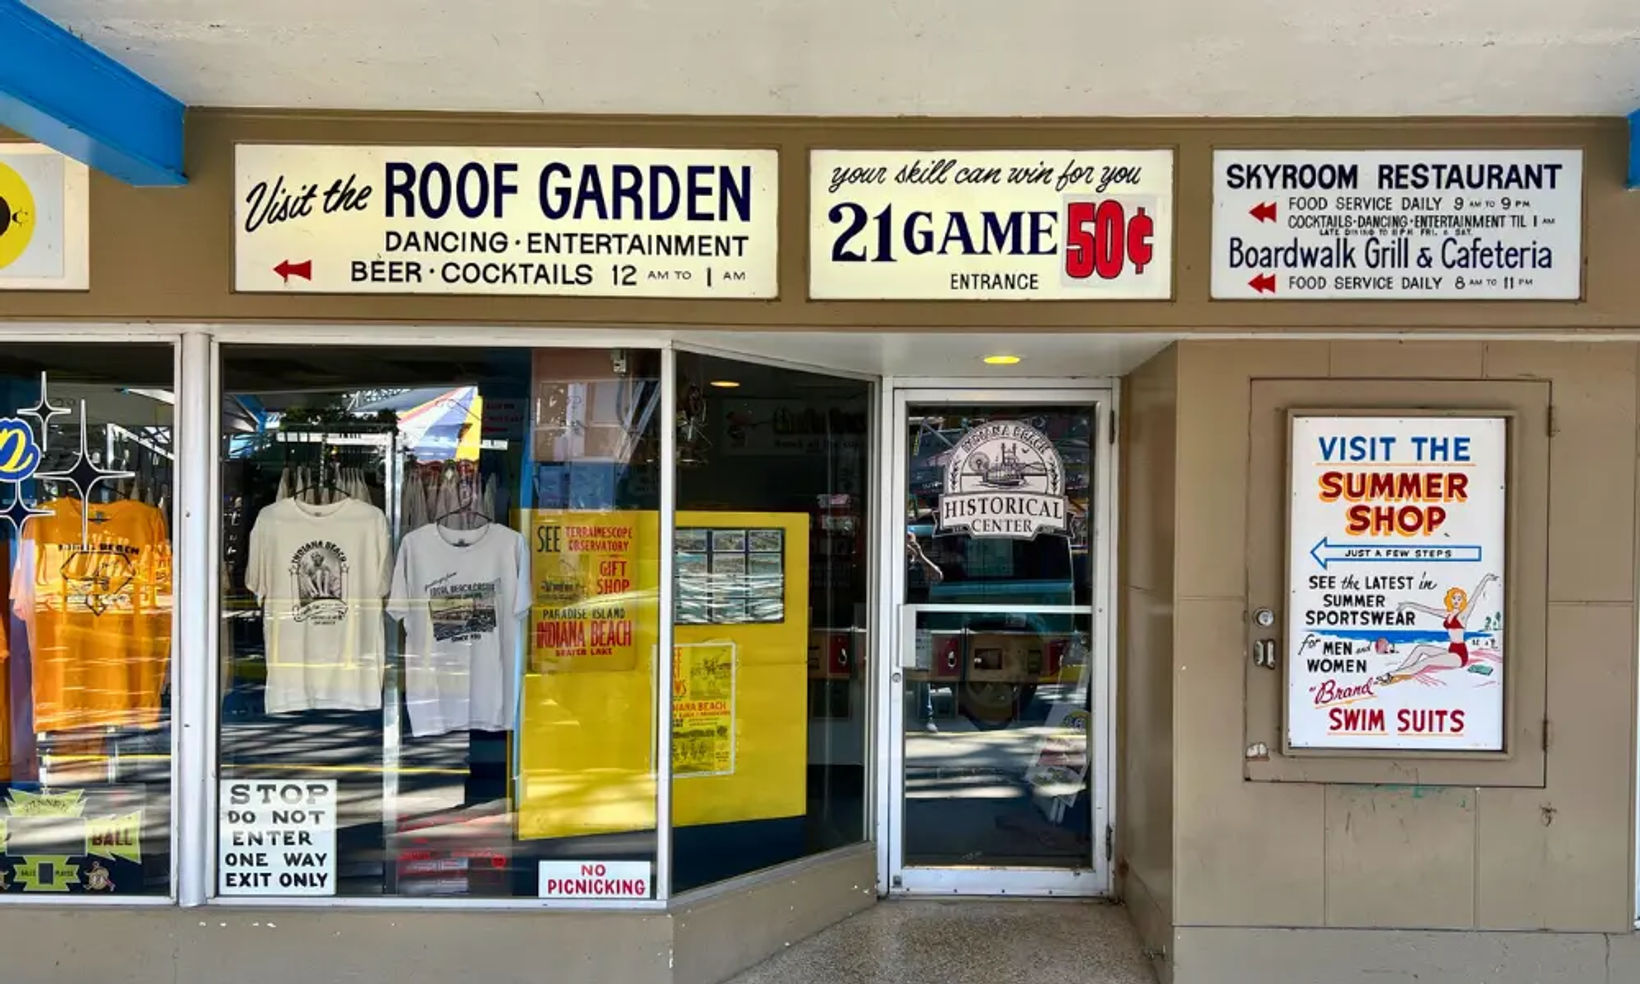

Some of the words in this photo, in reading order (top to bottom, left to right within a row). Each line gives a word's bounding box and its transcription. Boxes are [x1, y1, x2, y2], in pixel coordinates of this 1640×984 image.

[828, 165, 887, 192] your
[894, 159, 956, 184] skill
[954, 165, 1000, 183] can
[1007, 162, 1052, 183] win
[1055, 159, 1094, 191] for
[1096, 164, 1142, 192] you
[1226, 164, 1358, 190] SKYROOM
[1378, 164, 1562, 190] RESTAURANT
[245, 175, 317, 232] Visit
[322, 174, 372, 214] the
[385, 162, 518, 218] ROOF
[538, 162, 751, 222] GARDEN
[1289, 196, 1328, 211] FOOD
[1336, 196, 1392, 211] SERVICE
[1401, 196, 1442, 211] DAILY
[1453, 196, 1465, 211] 9
[1469, 200, 1483, 208] AM
[1485, 200, 1496, 208] TO
[1501, 196, 1512, 210] 9
[1515, 200, 1531, 208] PM
[1510, 214, 1527, 228] TIL
[385, 231, 508, 254] DANCING
[528, 234, 749, 257] ENTERTAINMENT
[828, 202, 898, 262] 21
[903, 211, 1058, 255] GAME
[1066, 199, 1154, 280] 50¢
[1229, 237, 1356, 269] Boardwalk
[1365, 237, 1408, 269] Grill
[1416, 248, 1433, 269] &
[1441, 237, 1553, 269] Cafeteria
[351, 260, 421, 283] BEER
[441, 261, 593, 285] COCKTAILS
[611, 265, 636, 286] 12
[647, 270, 669, 280] AM
[674, 270, 692, 280] TO
[723, 271, 746, 280] AM
[950, 273, 1039, 290] ENTRANCE
[1289, 276, 1327, 290] FOOD
[1334, 276, 1393, 290] SERVICE
[1401, 276, 1442, 290] DAILY
[1454, 276, 1466, 289] 8
[1504, 277, 1514, 289] 11
[1318, 436, 1396, 461] VISIT
[1411, 436, 1471, 461] THE
[1318, 471, 1469, 502] SUMMER
[945, 497, 1062, 519] HISTORICAL
[971, 519, 1032, 532] CENTER
[1344, 504, 1447, 537] SHOP
[537, 525, 560, 553] SEE
[1344, 549, 1371, 558] JUST
[1374, 549, 1383, 558] A
[1386, 549, 1410, 558] FEW
[1414, 549, 1452, 558] STEPS
[600, 560, 627, 577] GIFT
[597, 578, 630, 595] SHOP
[1309, 575, 1337, 590] SEE
[1340, 573, 1360, 591] the
[1365, 575, 1414, 590] LATEST
[1418, 571, 1438, 591] in
[1323, 594, 1386, 610] SUMMER
[542, 608, 587, 620] PARADISE
[592, 608, 625, 620] ISLAND
[1305, 610, 1416, 627] SPORTSWEAR
[536, 620, 586, 649] INDIANA
[590, 619, 632, 647] BEACH
[1298, 633, 1322, 656] for
[1322, 639, 1353, 657] MEN
[1355, 643, 1372, 655] and
[1306, 658, 1367, 674] WOMEN
[1329, 707, 1386, 732] SWIM
[1397, 708, 1465, 733] SUITS
[230, 784, 329, 805] STOP
[227, 810, 256, 824] DO
[272, 810, 325, 825] NOT
[92, 829, 133, 846] BALL
[232, 831, 313, 846] ENTER
[225, 853, 268, 867] ONE
[284, 853, 327, 867] WAY
[582, 864, 606, 877] NO
[226, 873, 272, 887] EXIT
[279, 872, 328, 888] ONLY
[548, 879, 646, 896] PICNICKING
